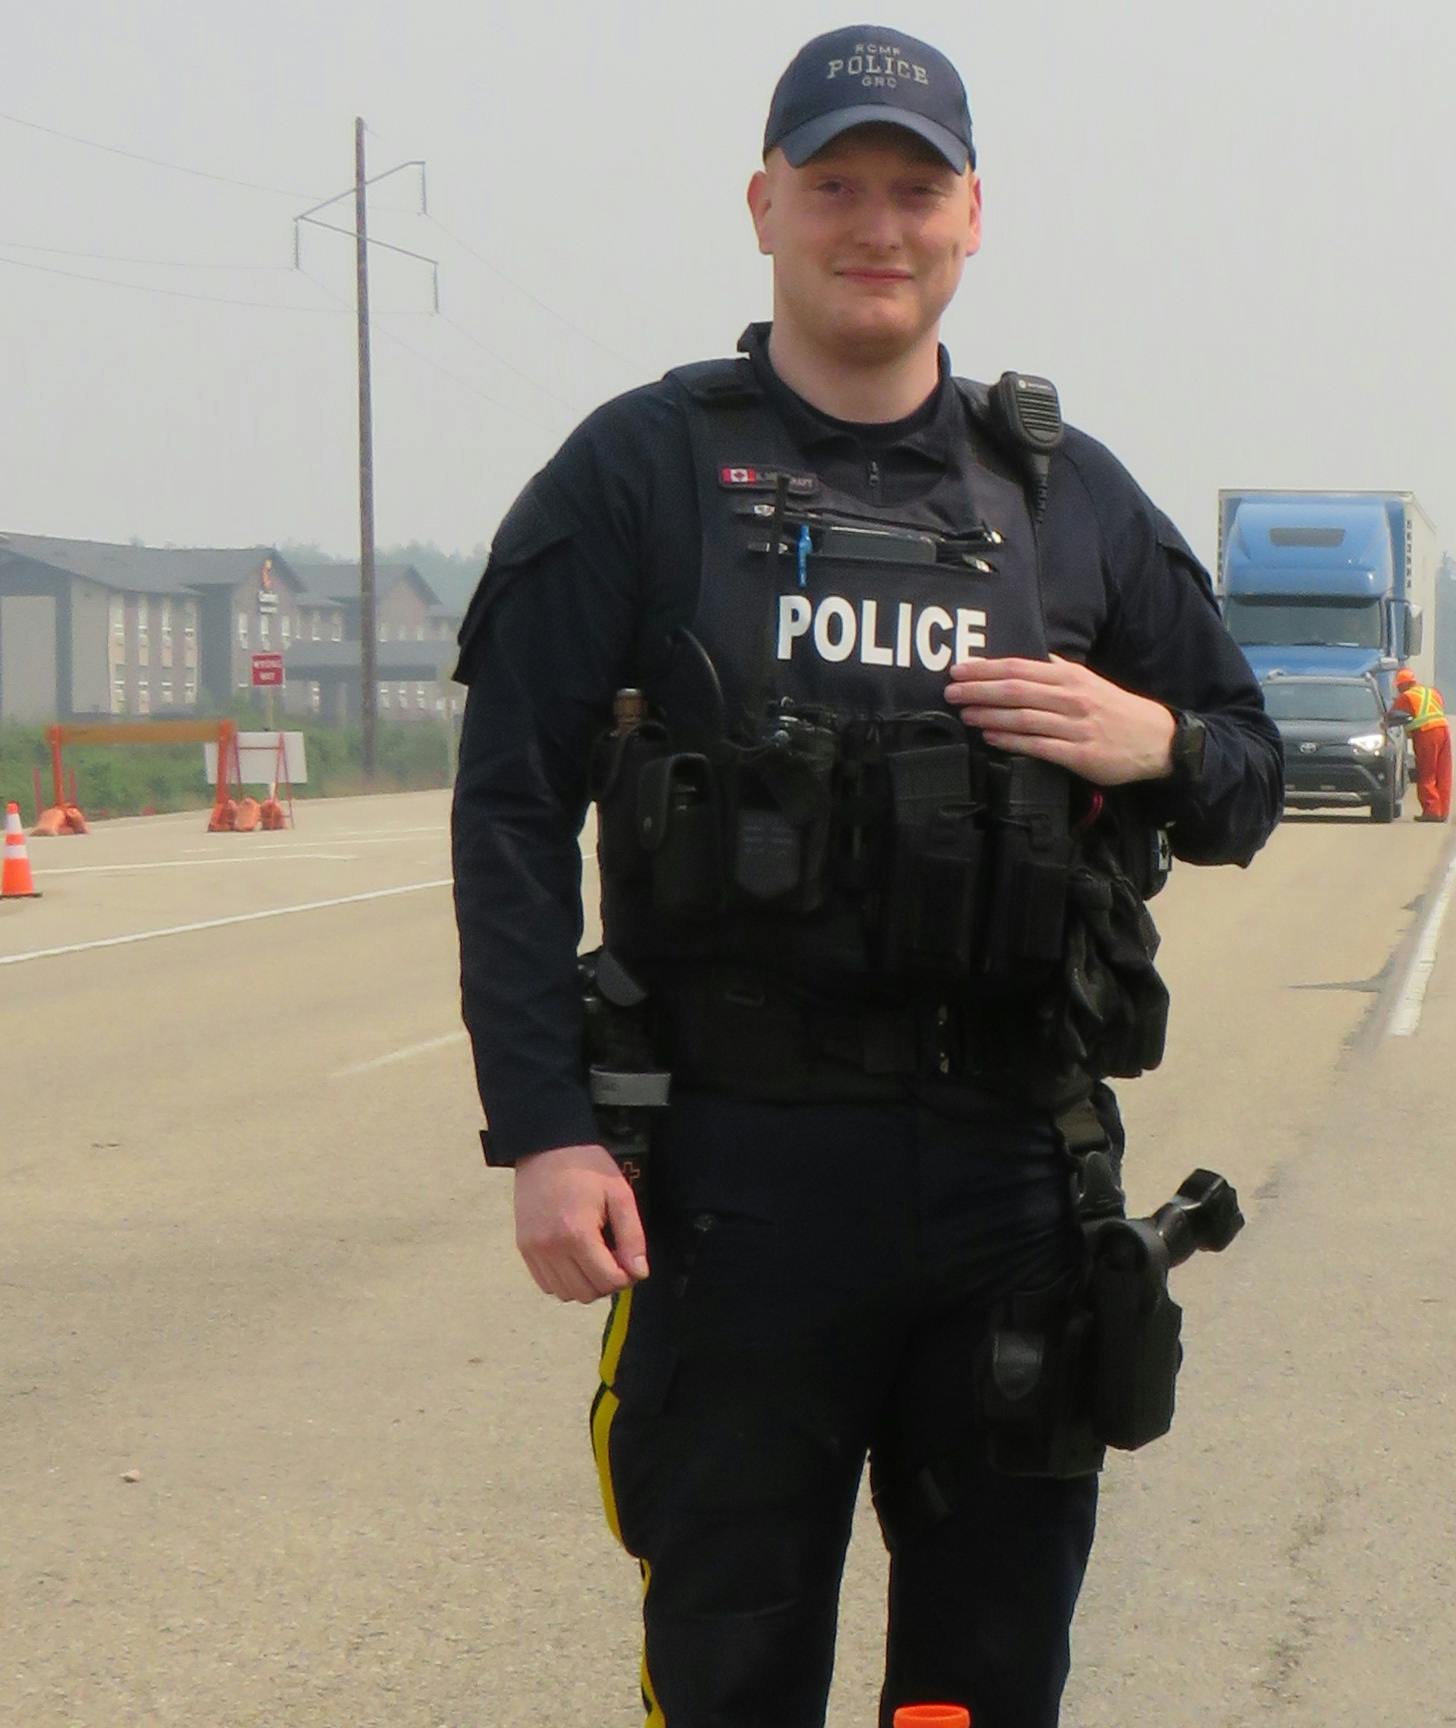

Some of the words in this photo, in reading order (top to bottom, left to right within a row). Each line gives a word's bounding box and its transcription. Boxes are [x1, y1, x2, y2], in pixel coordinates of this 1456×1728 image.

[855, 43, 900, 56] RCMP
[827, 55, 929, 85] POLICE
[862, 76, 897, 88] GRC
[777, 595, 987, 672] POLICE
